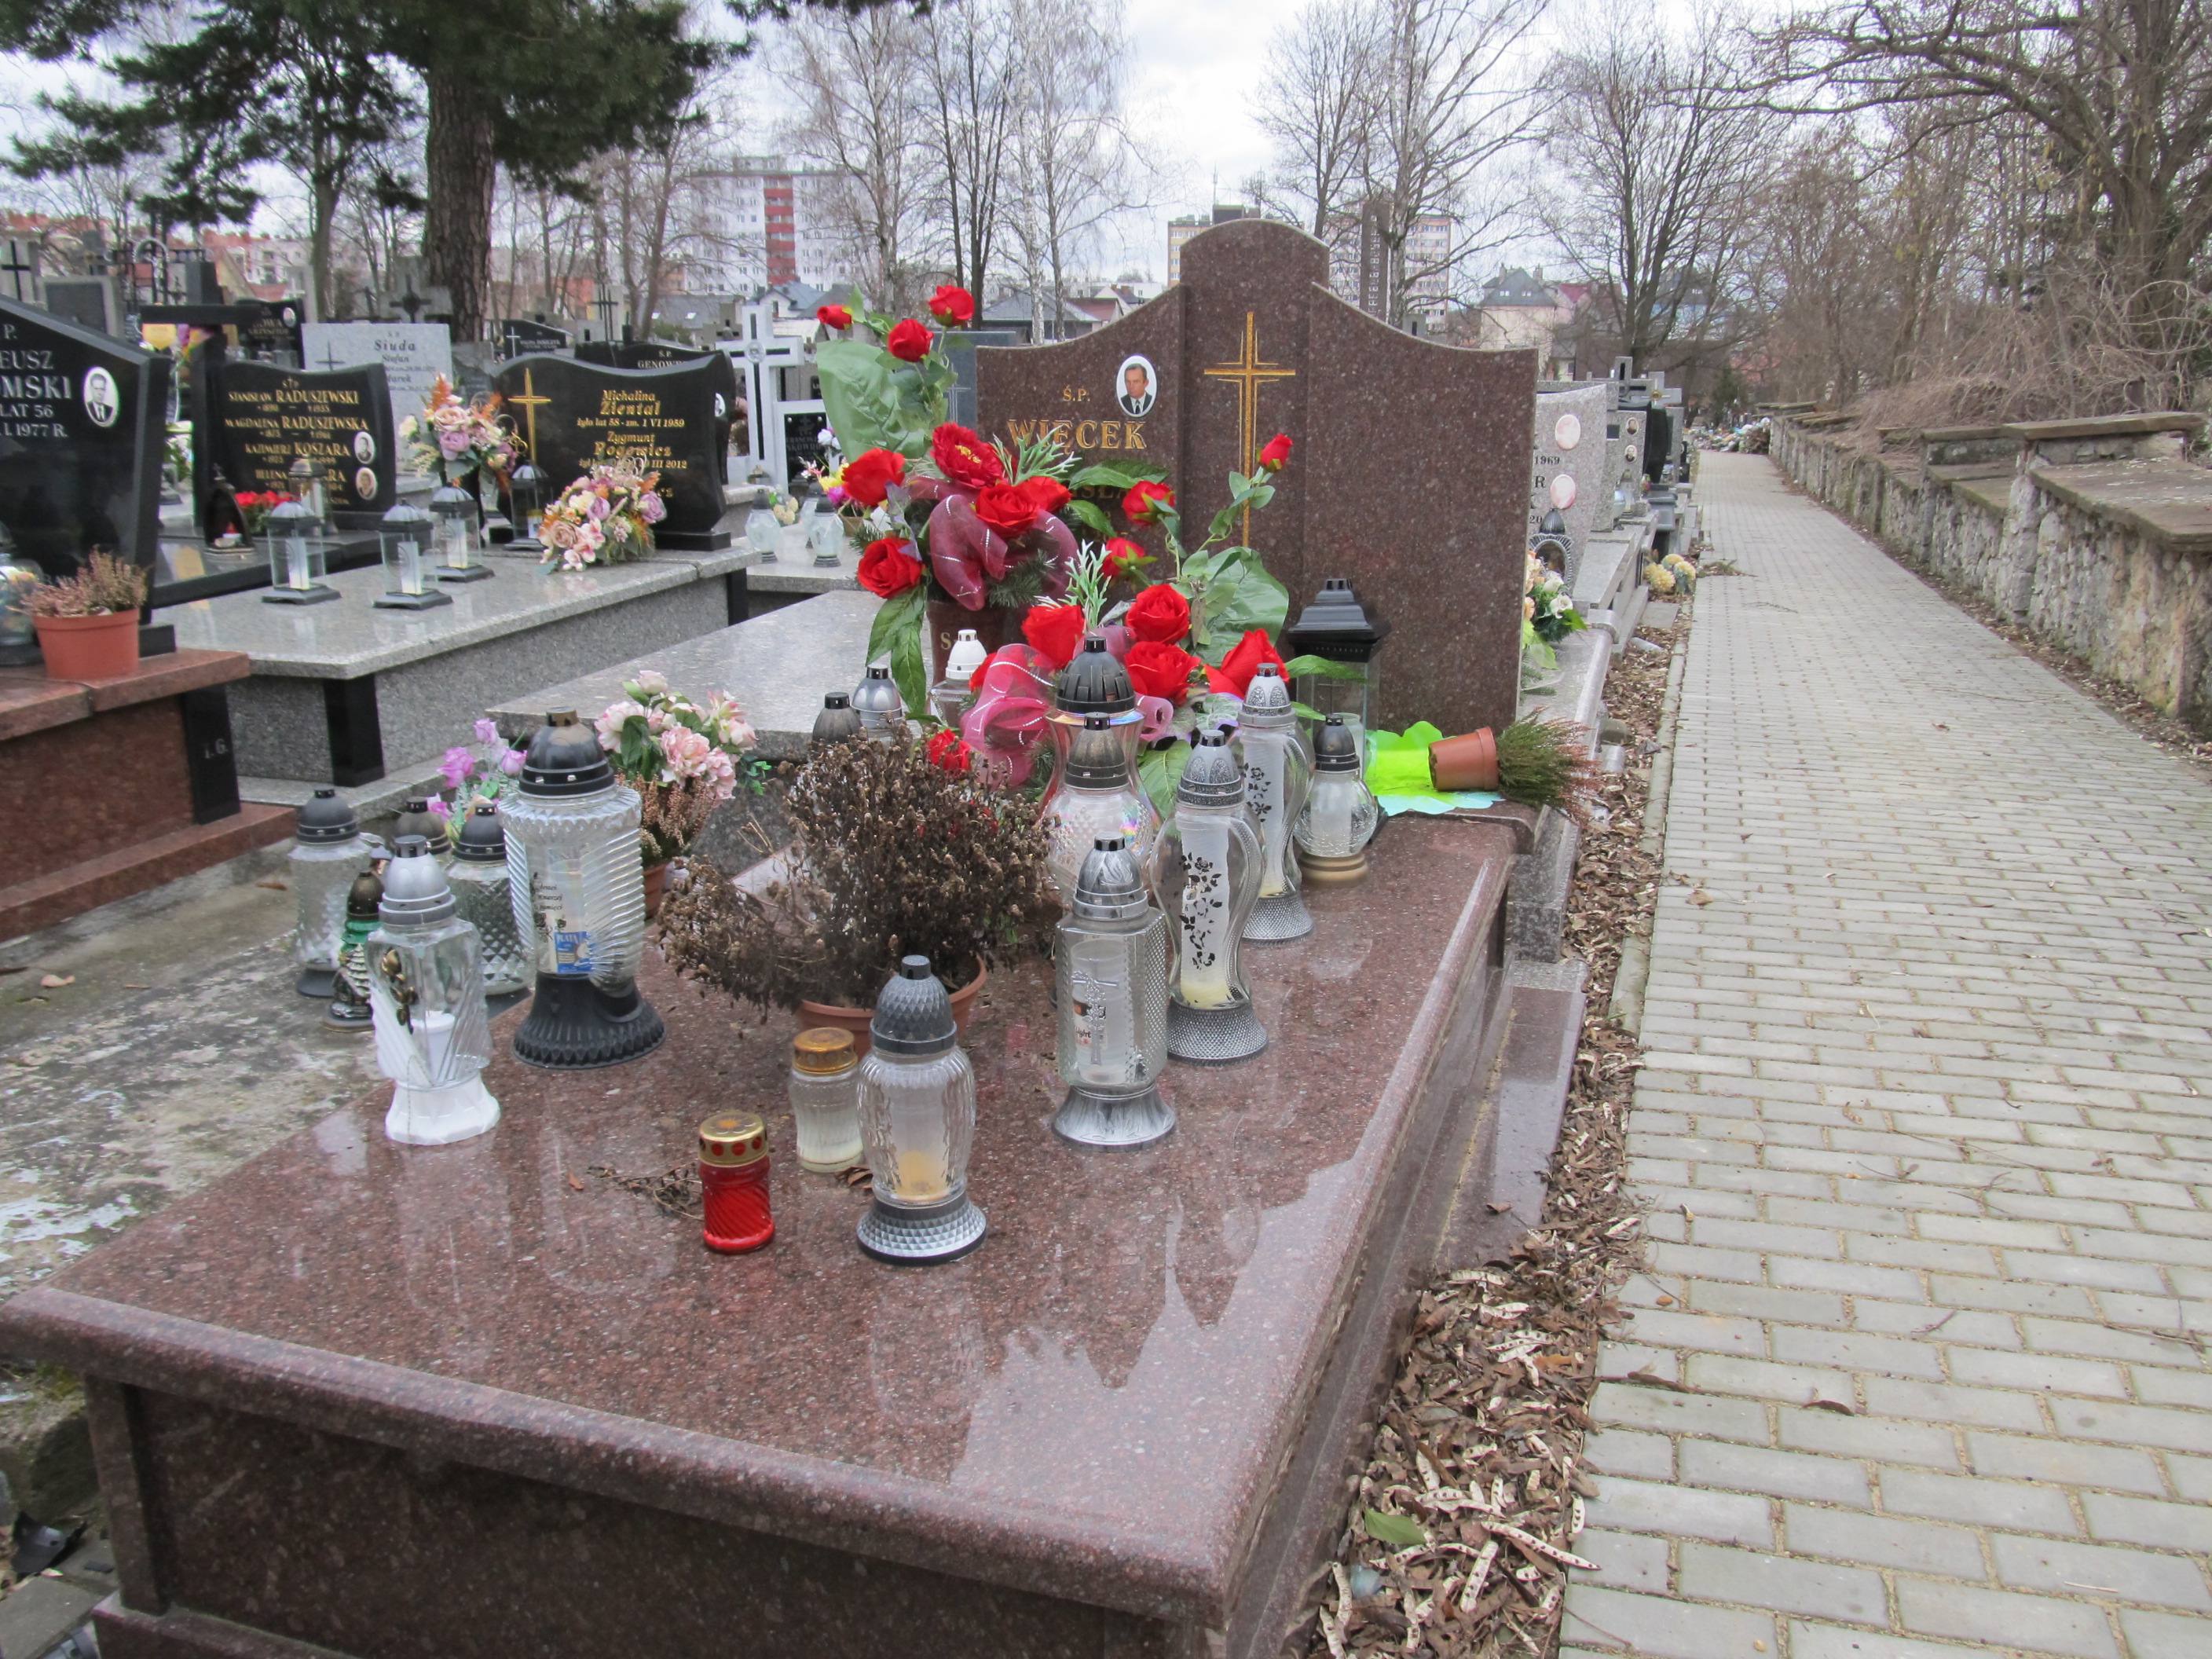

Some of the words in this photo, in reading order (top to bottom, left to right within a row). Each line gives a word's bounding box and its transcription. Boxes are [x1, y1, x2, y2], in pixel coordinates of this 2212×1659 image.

[375, 339, 416, 351] Siuda
[276, 389, 360, 405] RADUSZEWSKI
[602, 390, 655, 401] Michalina
[34, 404, 53, 418] 56
[225, 417, 280, 429] MAGDALENA
[281, 416, 369, 430] RADUSZEWSKA
[607, 430, 655, 445] Zygmunt
[1006, 418, 1148, 456] WIĘCEK
[245, 444, 291, 455] KAZIMIERZ
[294, 442, 351, 456] KOSZARA
[665, 460, 687, 469] 2012
[1534, 456, 1560, 465] 1969
